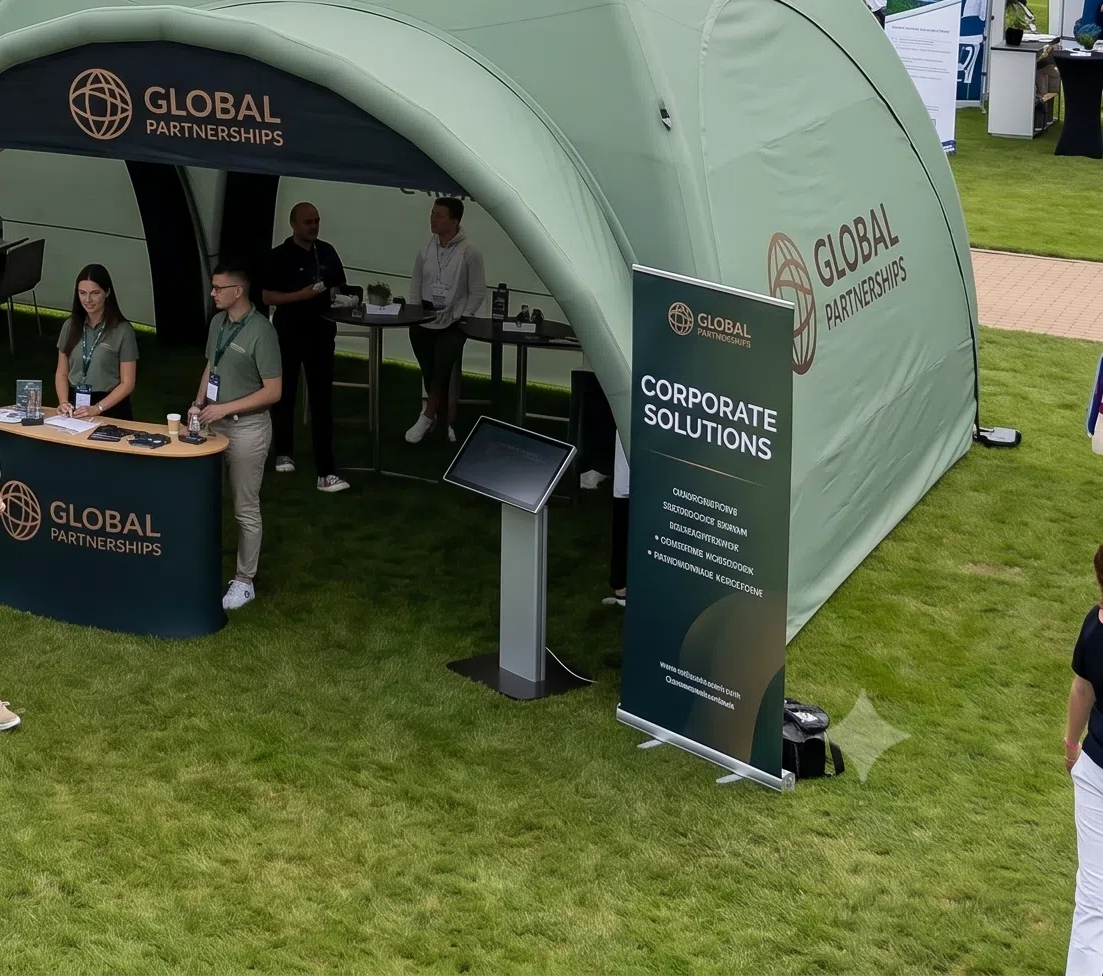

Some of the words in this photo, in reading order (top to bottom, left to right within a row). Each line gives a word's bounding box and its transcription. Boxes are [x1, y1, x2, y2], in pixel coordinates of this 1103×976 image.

[144, 86, 281, 124] GLOBAL
[146, 120, 284, 147] PARTNERSHIPS
[813, 202, 900, 288] GLOBAL
[824, 255, 908, 331] PARTNERSHIPS
[697, 312, 752, 338] GLOBAL
[641, 374, 778, 433] CORPORATE
[644, 403, 772, 460] SOLUTIONS
[50, 500, 162, 538] GLOBAL
[51, 527, 162, 556] PARTNERSHIPS
